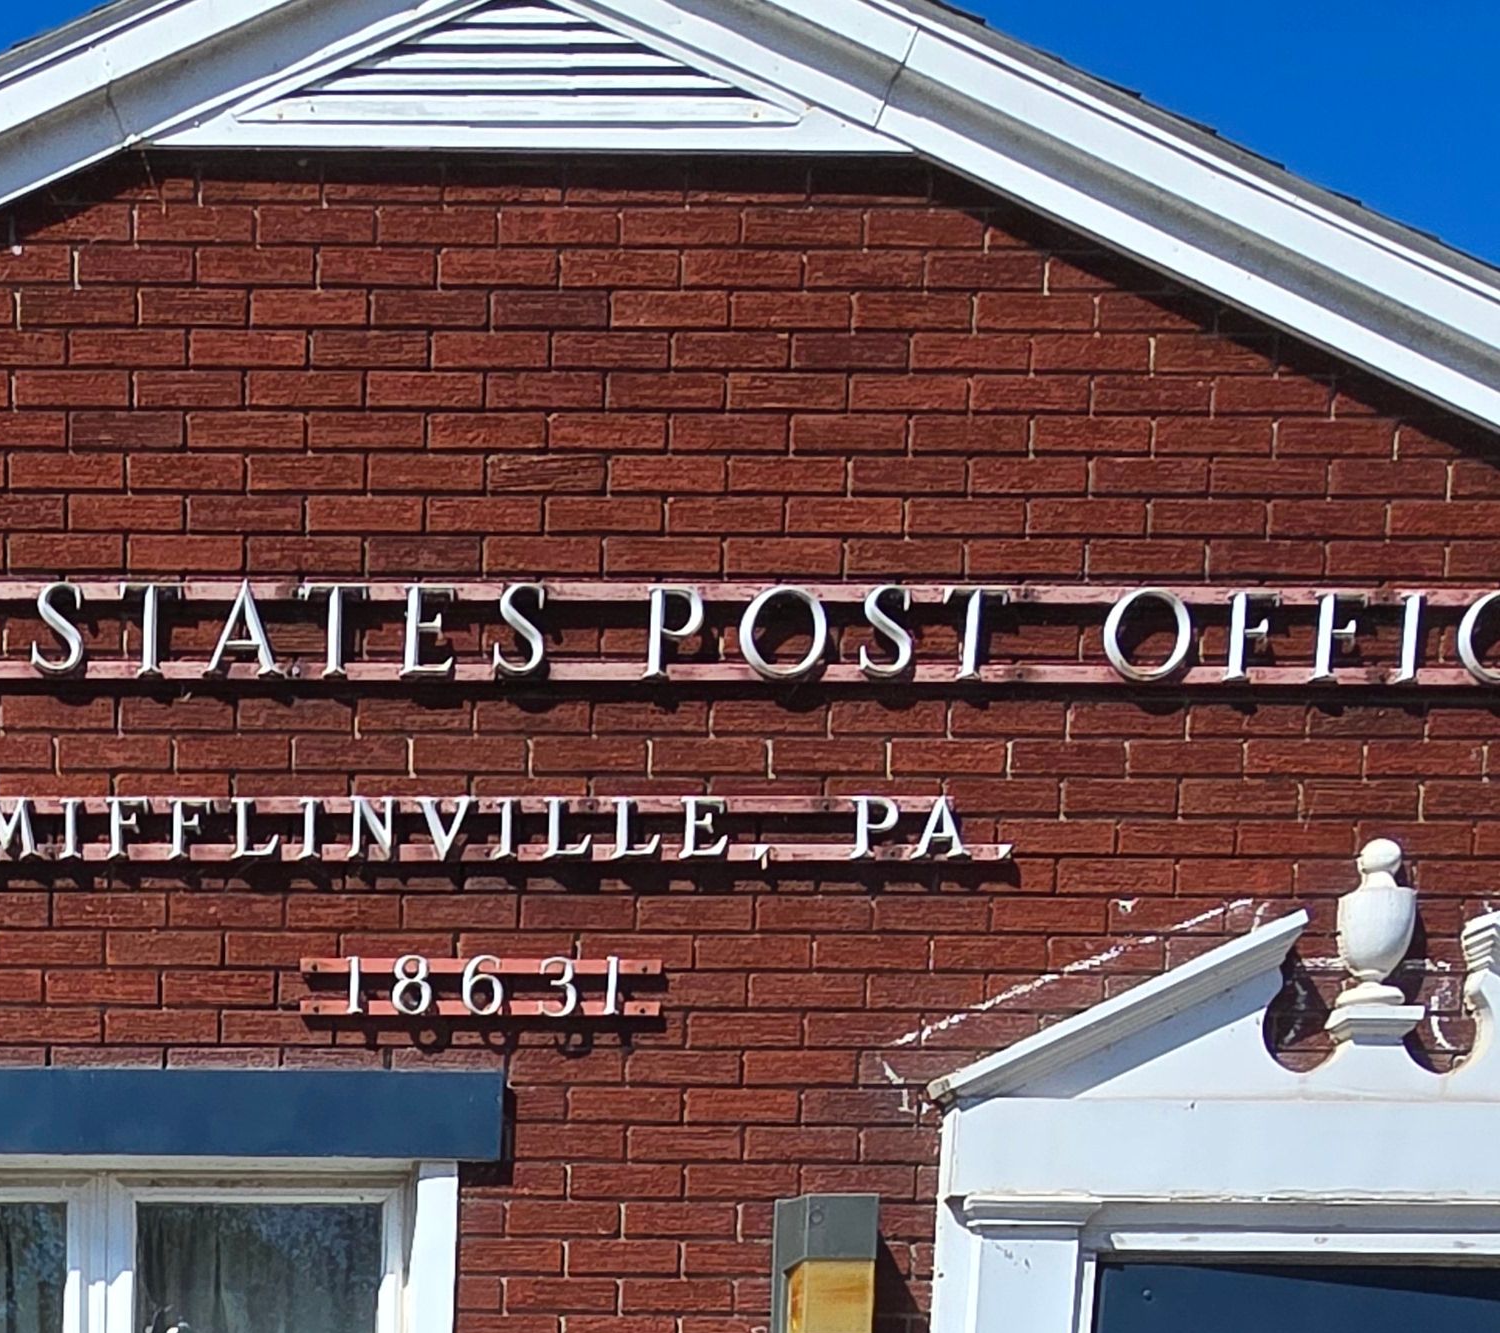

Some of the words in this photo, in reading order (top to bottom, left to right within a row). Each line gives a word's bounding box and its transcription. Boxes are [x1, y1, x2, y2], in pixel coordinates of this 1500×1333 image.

[31, 579, 546, 677] STATES
[643, 584, 1008, 681] POST
[850, 795, 1013, 860] PA.
[345, 955, 620, 1017] 18631
